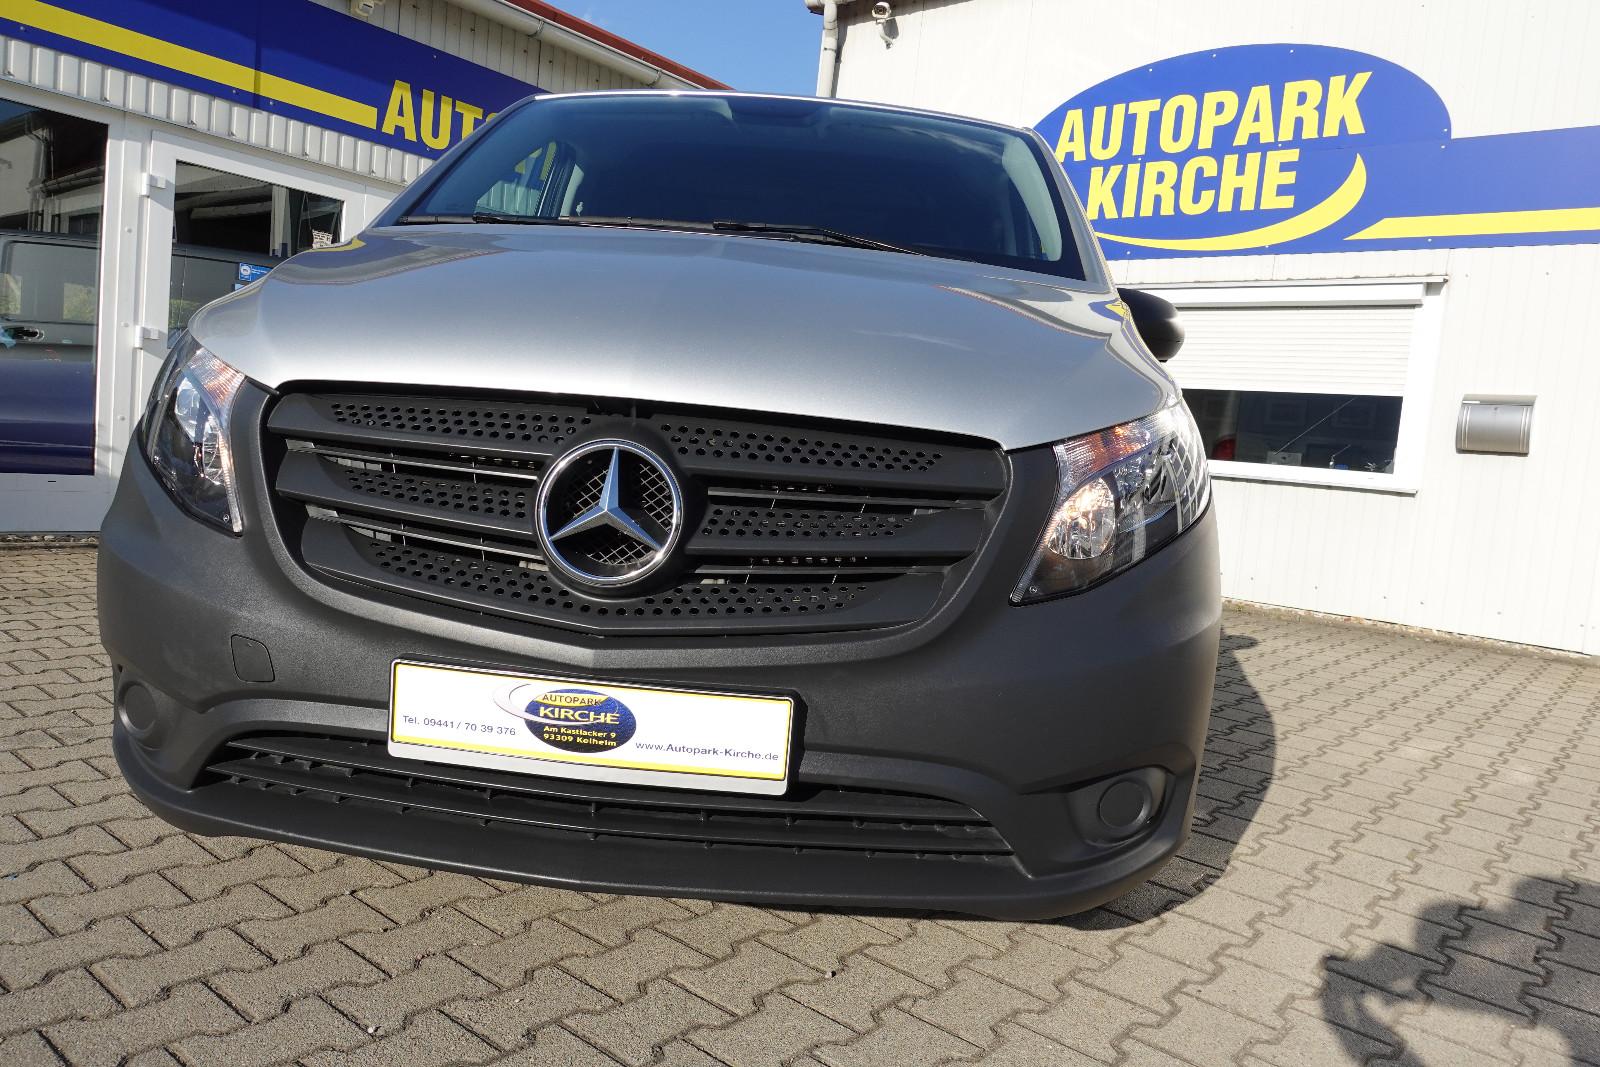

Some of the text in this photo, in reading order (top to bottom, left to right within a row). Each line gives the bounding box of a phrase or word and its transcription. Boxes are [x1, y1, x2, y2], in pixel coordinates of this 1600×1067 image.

[381, 79, 501, 150] AUT
[1054, 71, 1373, 164] AUTOPARK
[1086, 148, 1300, 221] KIRCHE
[542, 694, 602, 706] AUTOPARK
[539, 706, 620, 724] KIRCHE
[403, 715, 420, 725] Tel.
[465, 722, 477, 731] 70
[480, 724, 493, 733] 39
[496, 726, 516, 736] 376
[543, 725, 558, 733] Am
[543, 733, 574, 742] 93309
[635, 741, 779, 761] www.Autopark-Kirche.de
